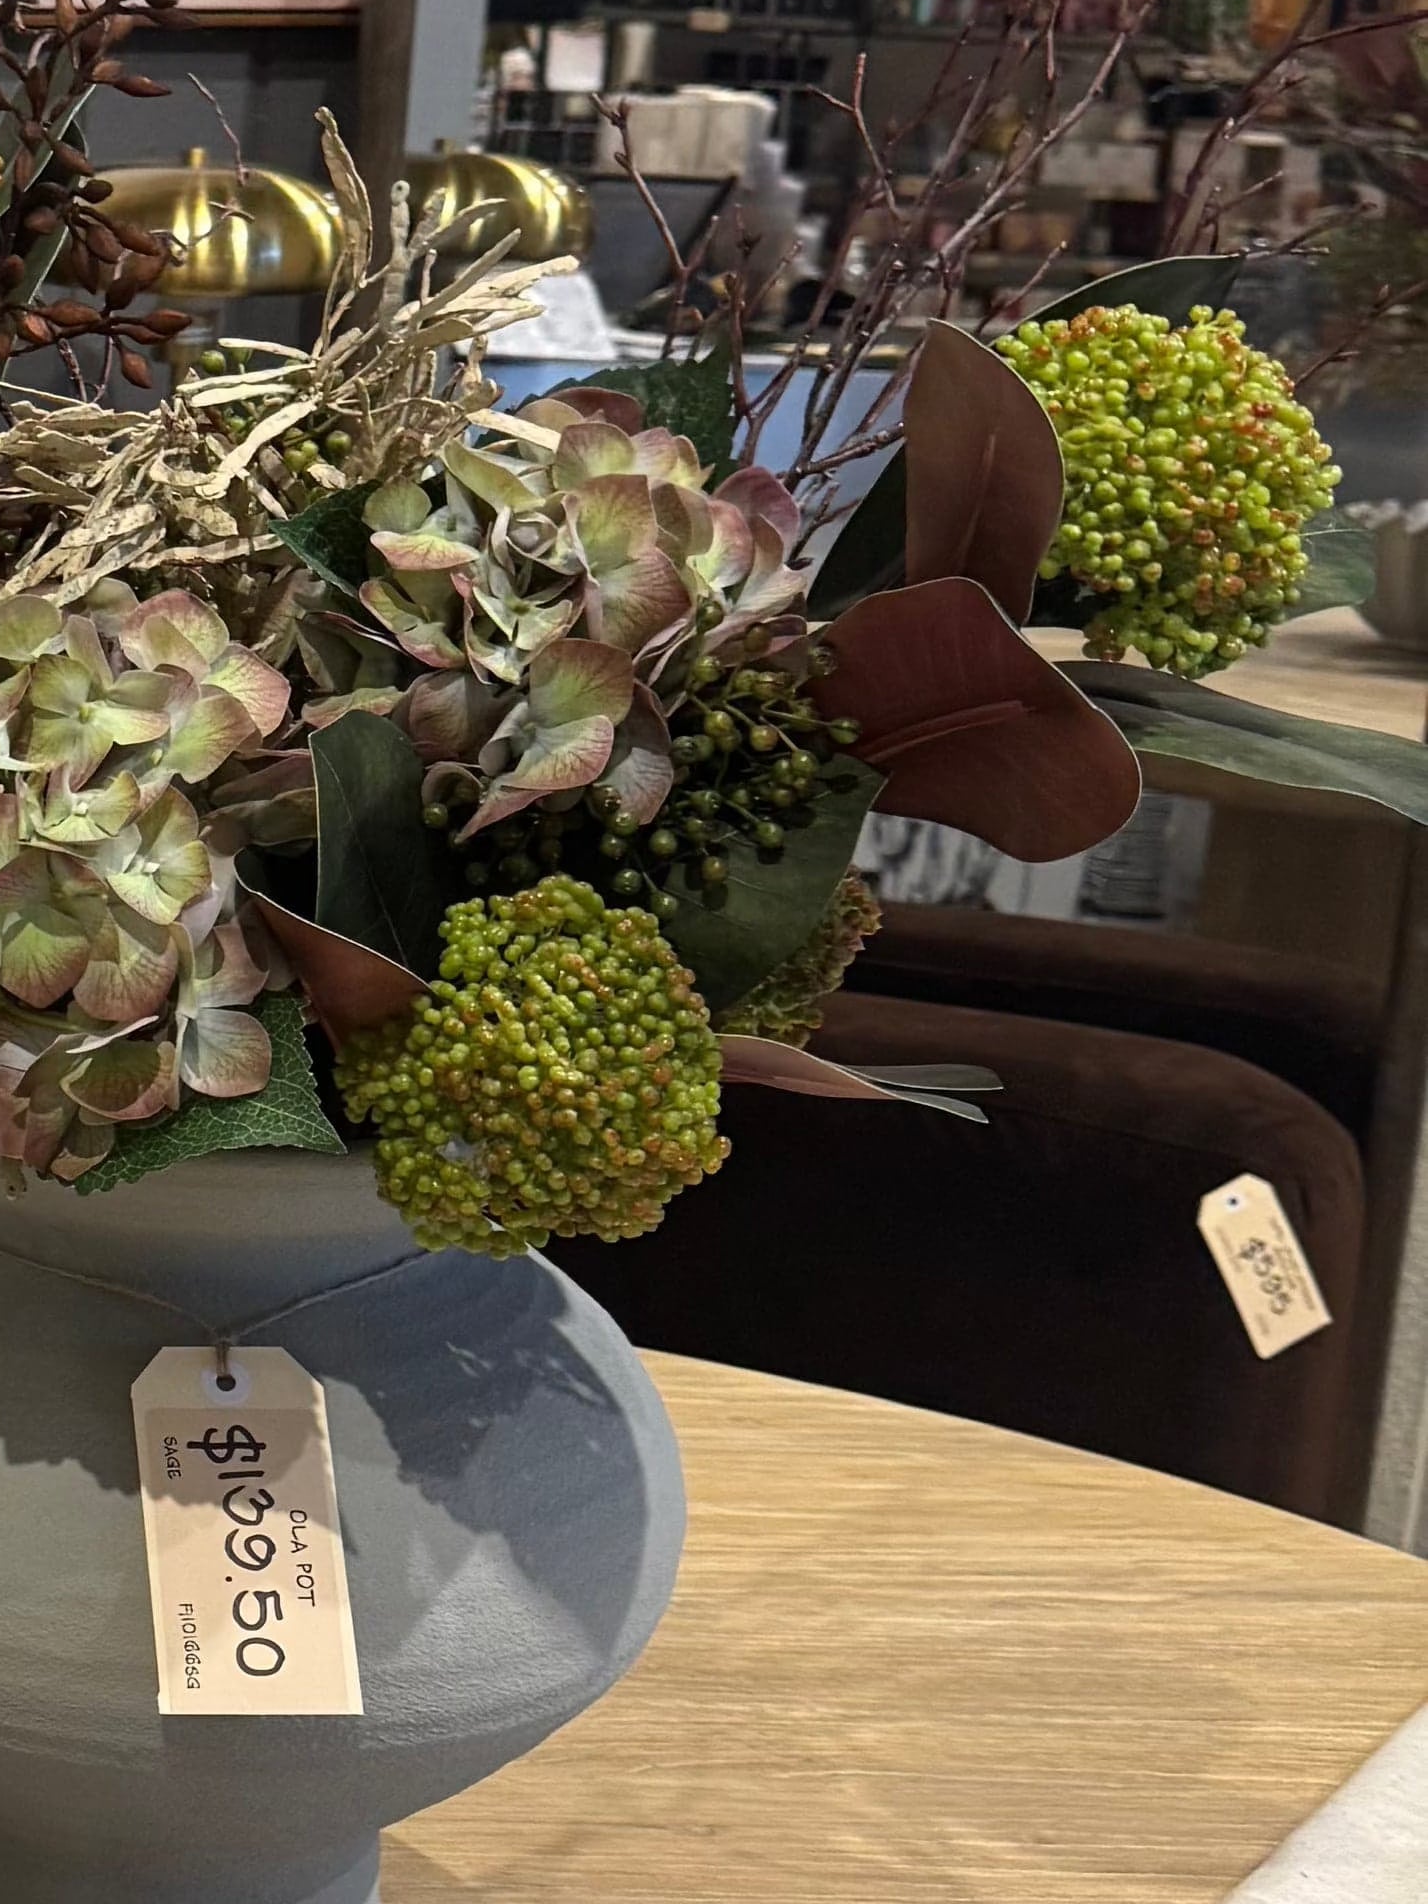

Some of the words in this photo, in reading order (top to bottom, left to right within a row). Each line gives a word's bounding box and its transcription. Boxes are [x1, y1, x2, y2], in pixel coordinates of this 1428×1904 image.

[163, 1436, 182, 1480] SAGE
[186, 1424, 286, 1677] $139.50
[289, 1509, 309, 1554] OLA
[296, 1563, 317, 1608] POT
